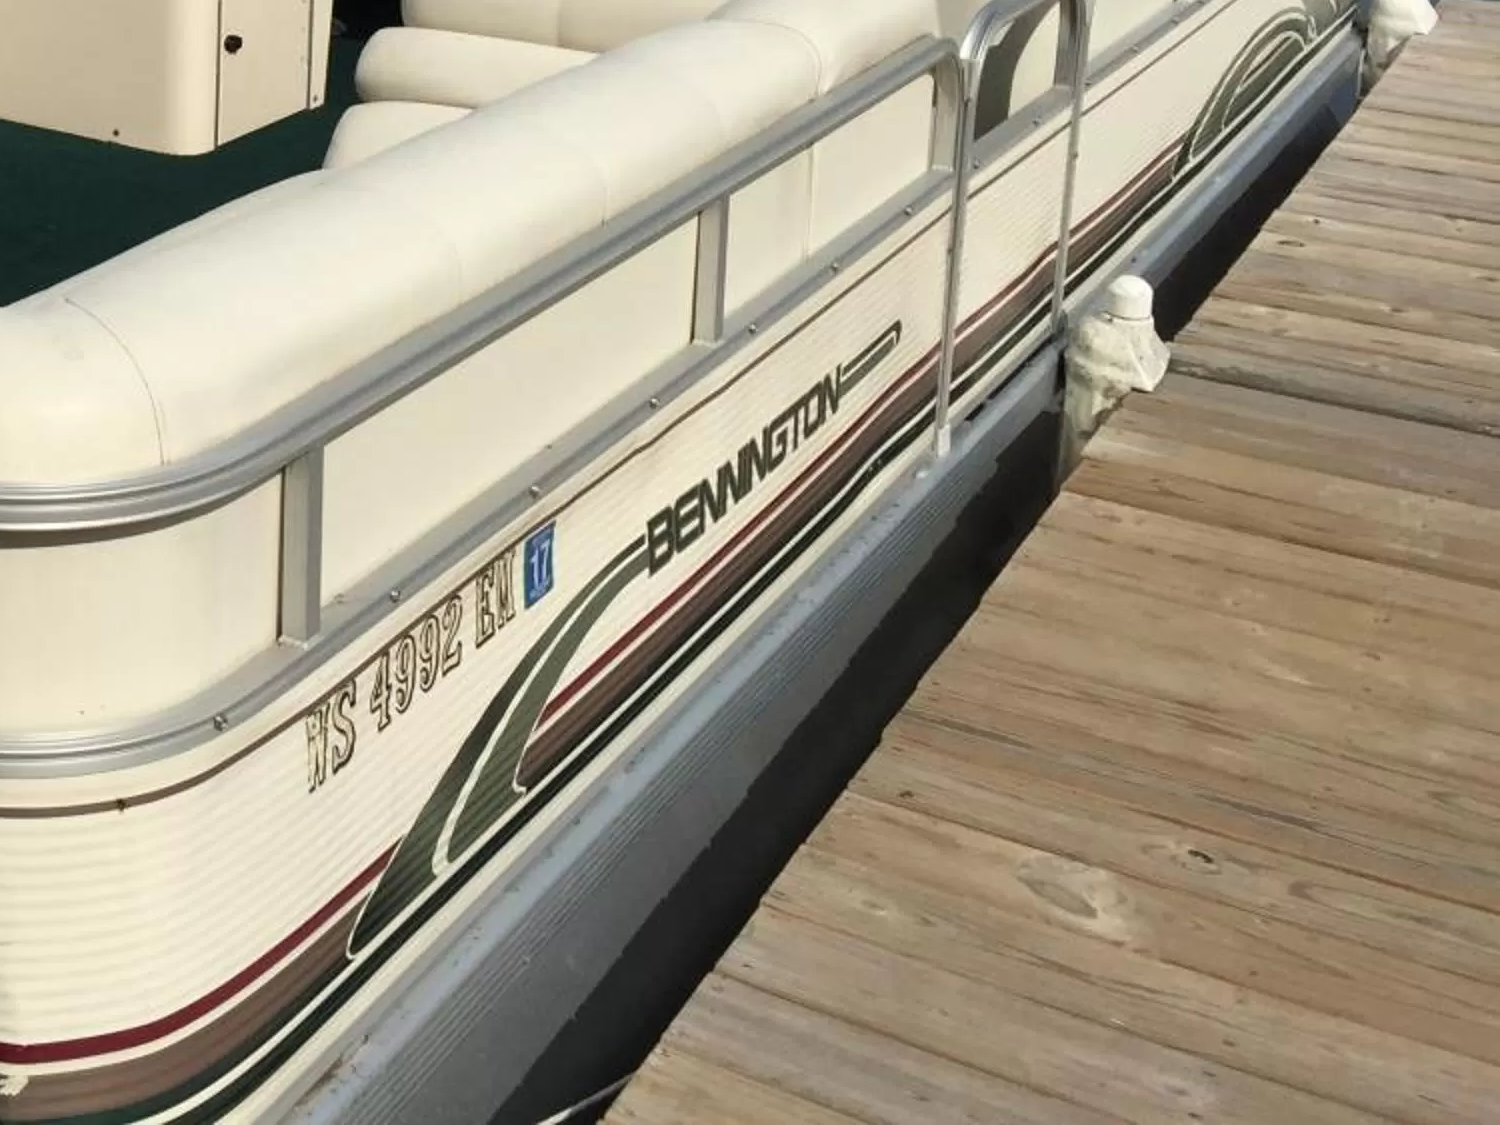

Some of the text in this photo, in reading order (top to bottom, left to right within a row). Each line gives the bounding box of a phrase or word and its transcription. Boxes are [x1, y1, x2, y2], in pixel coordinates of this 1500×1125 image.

[646, 362, 843, 579] BENNINGTON
[305, 675, 357, 793] WS
[369, 594, 463, 733] 4992
